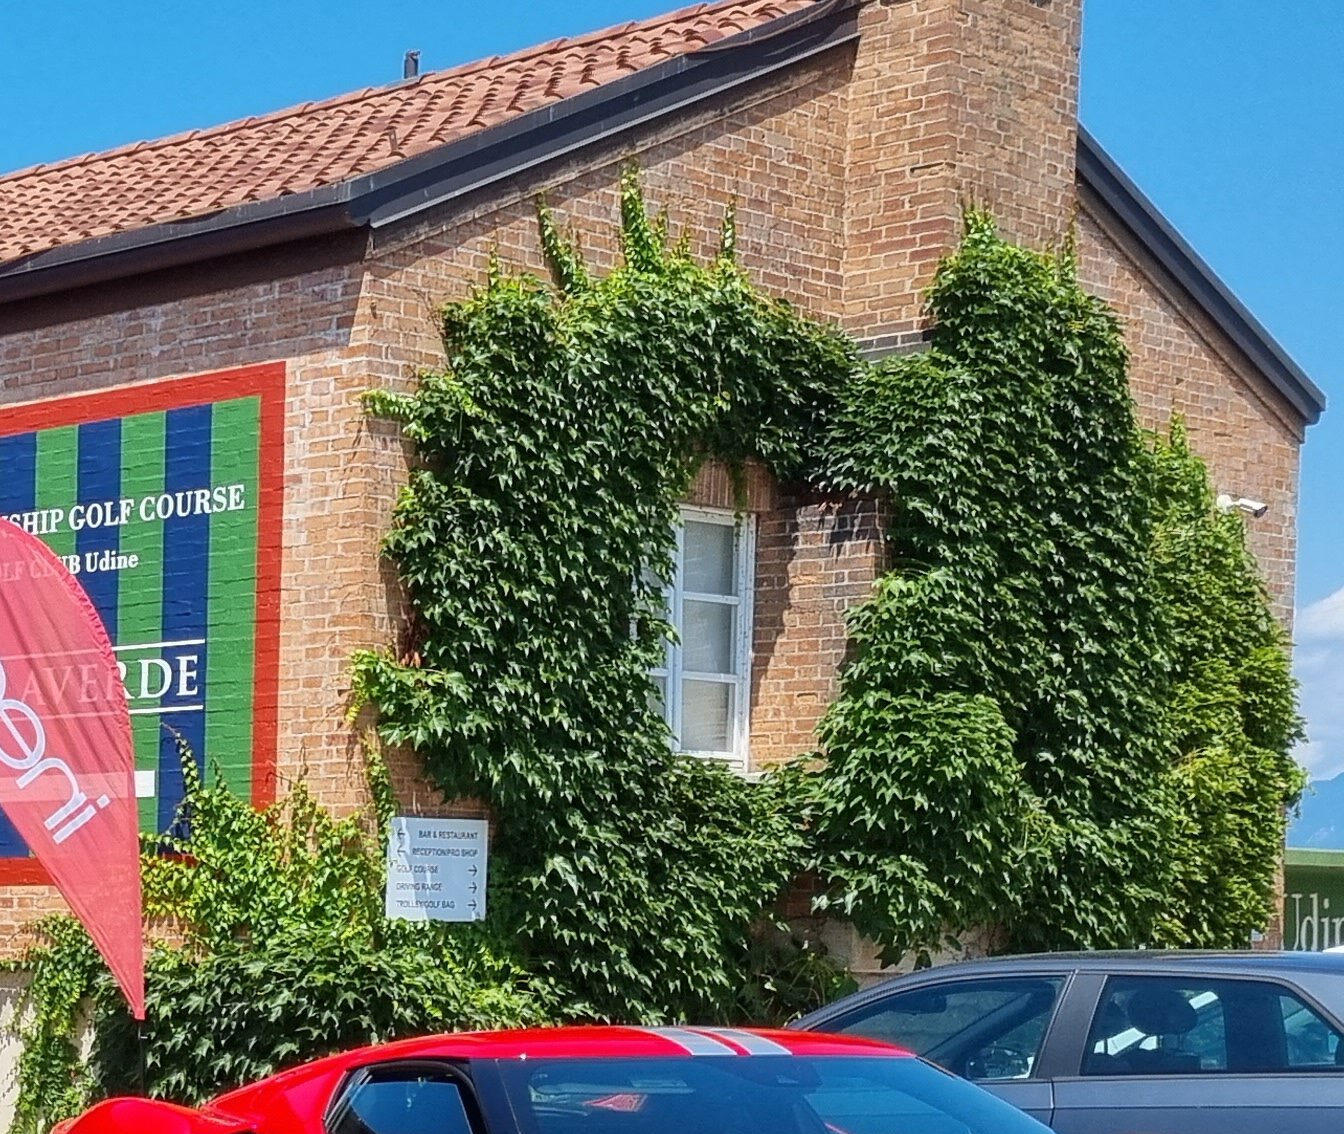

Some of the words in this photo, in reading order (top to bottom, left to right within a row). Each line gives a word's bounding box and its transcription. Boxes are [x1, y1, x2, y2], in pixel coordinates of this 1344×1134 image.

[68, 498, 134, 532] GOLF
[139, 484, 246, 522] COURSE
[86, 550, 139, 572] Udine
[418, 830, 431, 839] BAR
[438, 831, 479, 840] RESTAURANT
[461, 848, 478, 857] SHOP
[396, 864, 413, 873] GOLF
[413, 865, 438, 874] COURSE
[396, 882, 421, 891] DRIVING
[421, 882, 442, 892] RANGE
[441, 900, 455, 909] BAG
